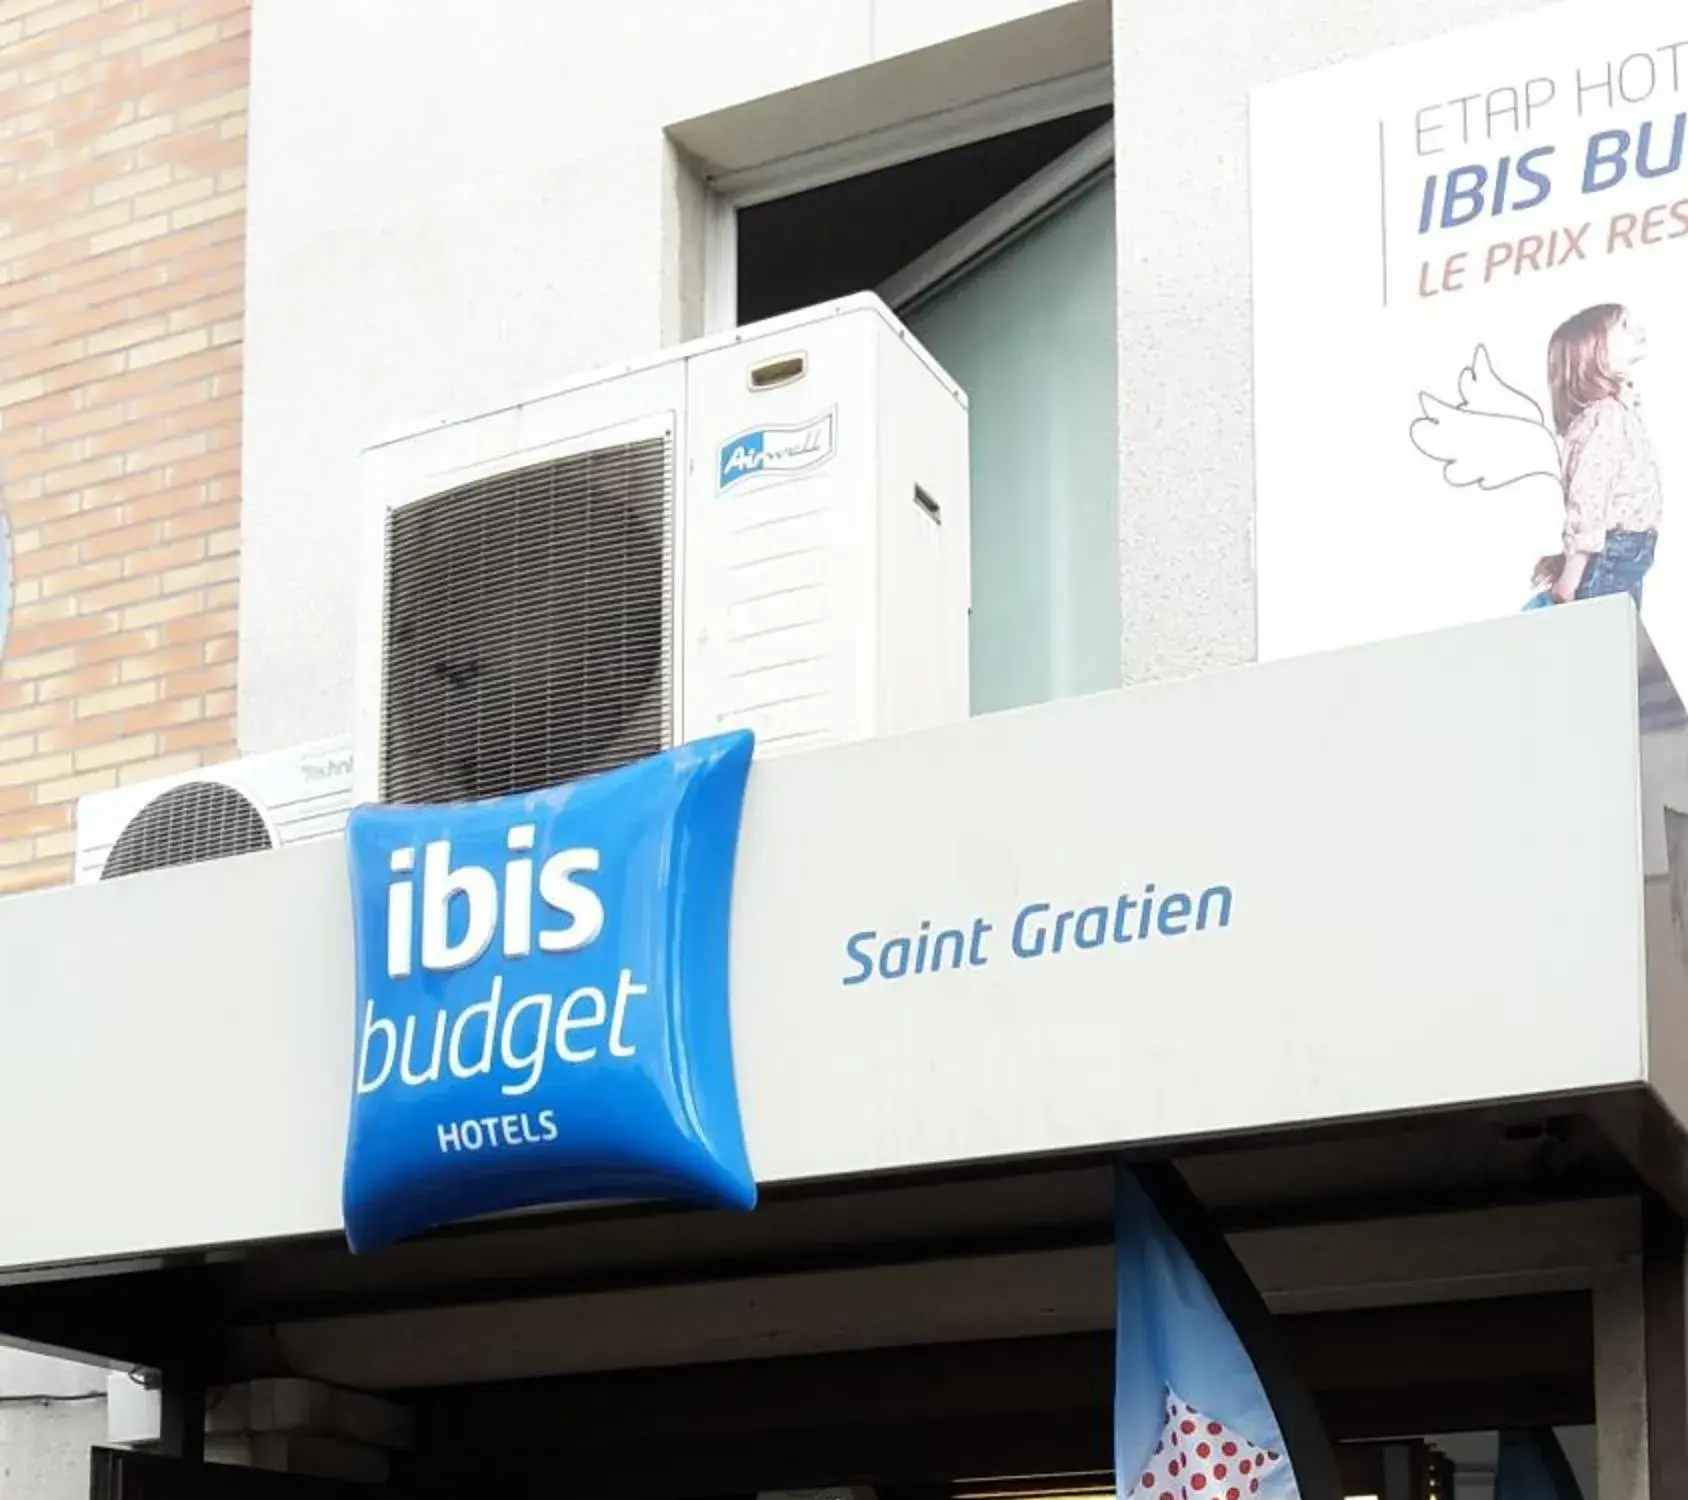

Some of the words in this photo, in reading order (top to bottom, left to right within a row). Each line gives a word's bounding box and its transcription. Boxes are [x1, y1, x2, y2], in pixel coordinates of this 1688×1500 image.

[1415, 77, 1556, 157] ETAP
[1418, 145, 1556, 235] IBIS
[1581, 111, 1688, 195] BU
[1418, 252, 1469, 298] LE
[1483, 221, 1592, 285] PRIX
[387, 823, 605, 980] ibis
[842, 917, 993, 986] Saint
[1010, 882, 1234, 960] Gratien
[356, 967, 648, 1096] budget
[436, 1109, 559, 1154] HOTELS
